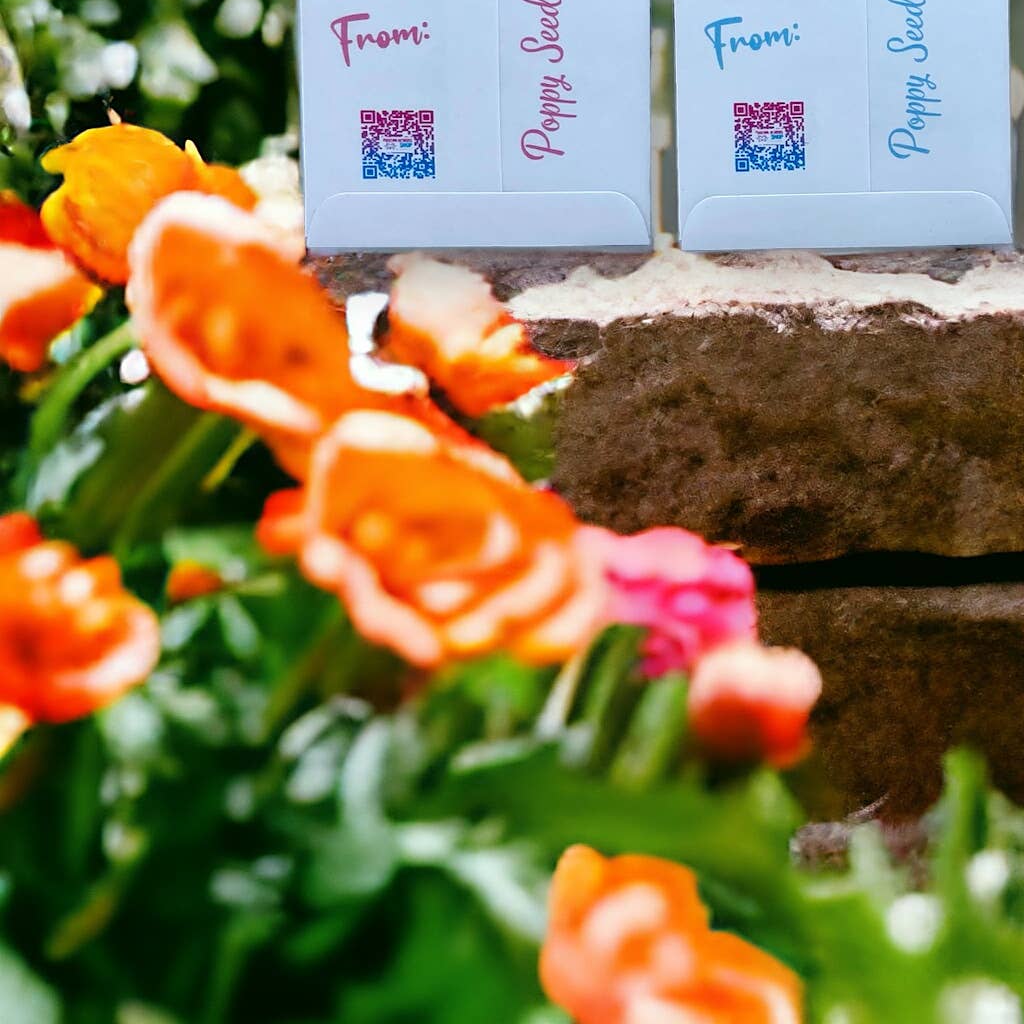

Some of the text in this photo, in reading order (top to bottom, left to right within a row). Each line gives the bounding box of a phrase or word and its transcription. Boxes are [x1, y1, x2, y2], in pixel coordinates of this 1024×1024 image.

[330, 13, 430, 67] From:
[705, 16, 800, 70] From:
[520, 74, 577, 162] Poppy
[889, 74, 942, 160] Poppy
